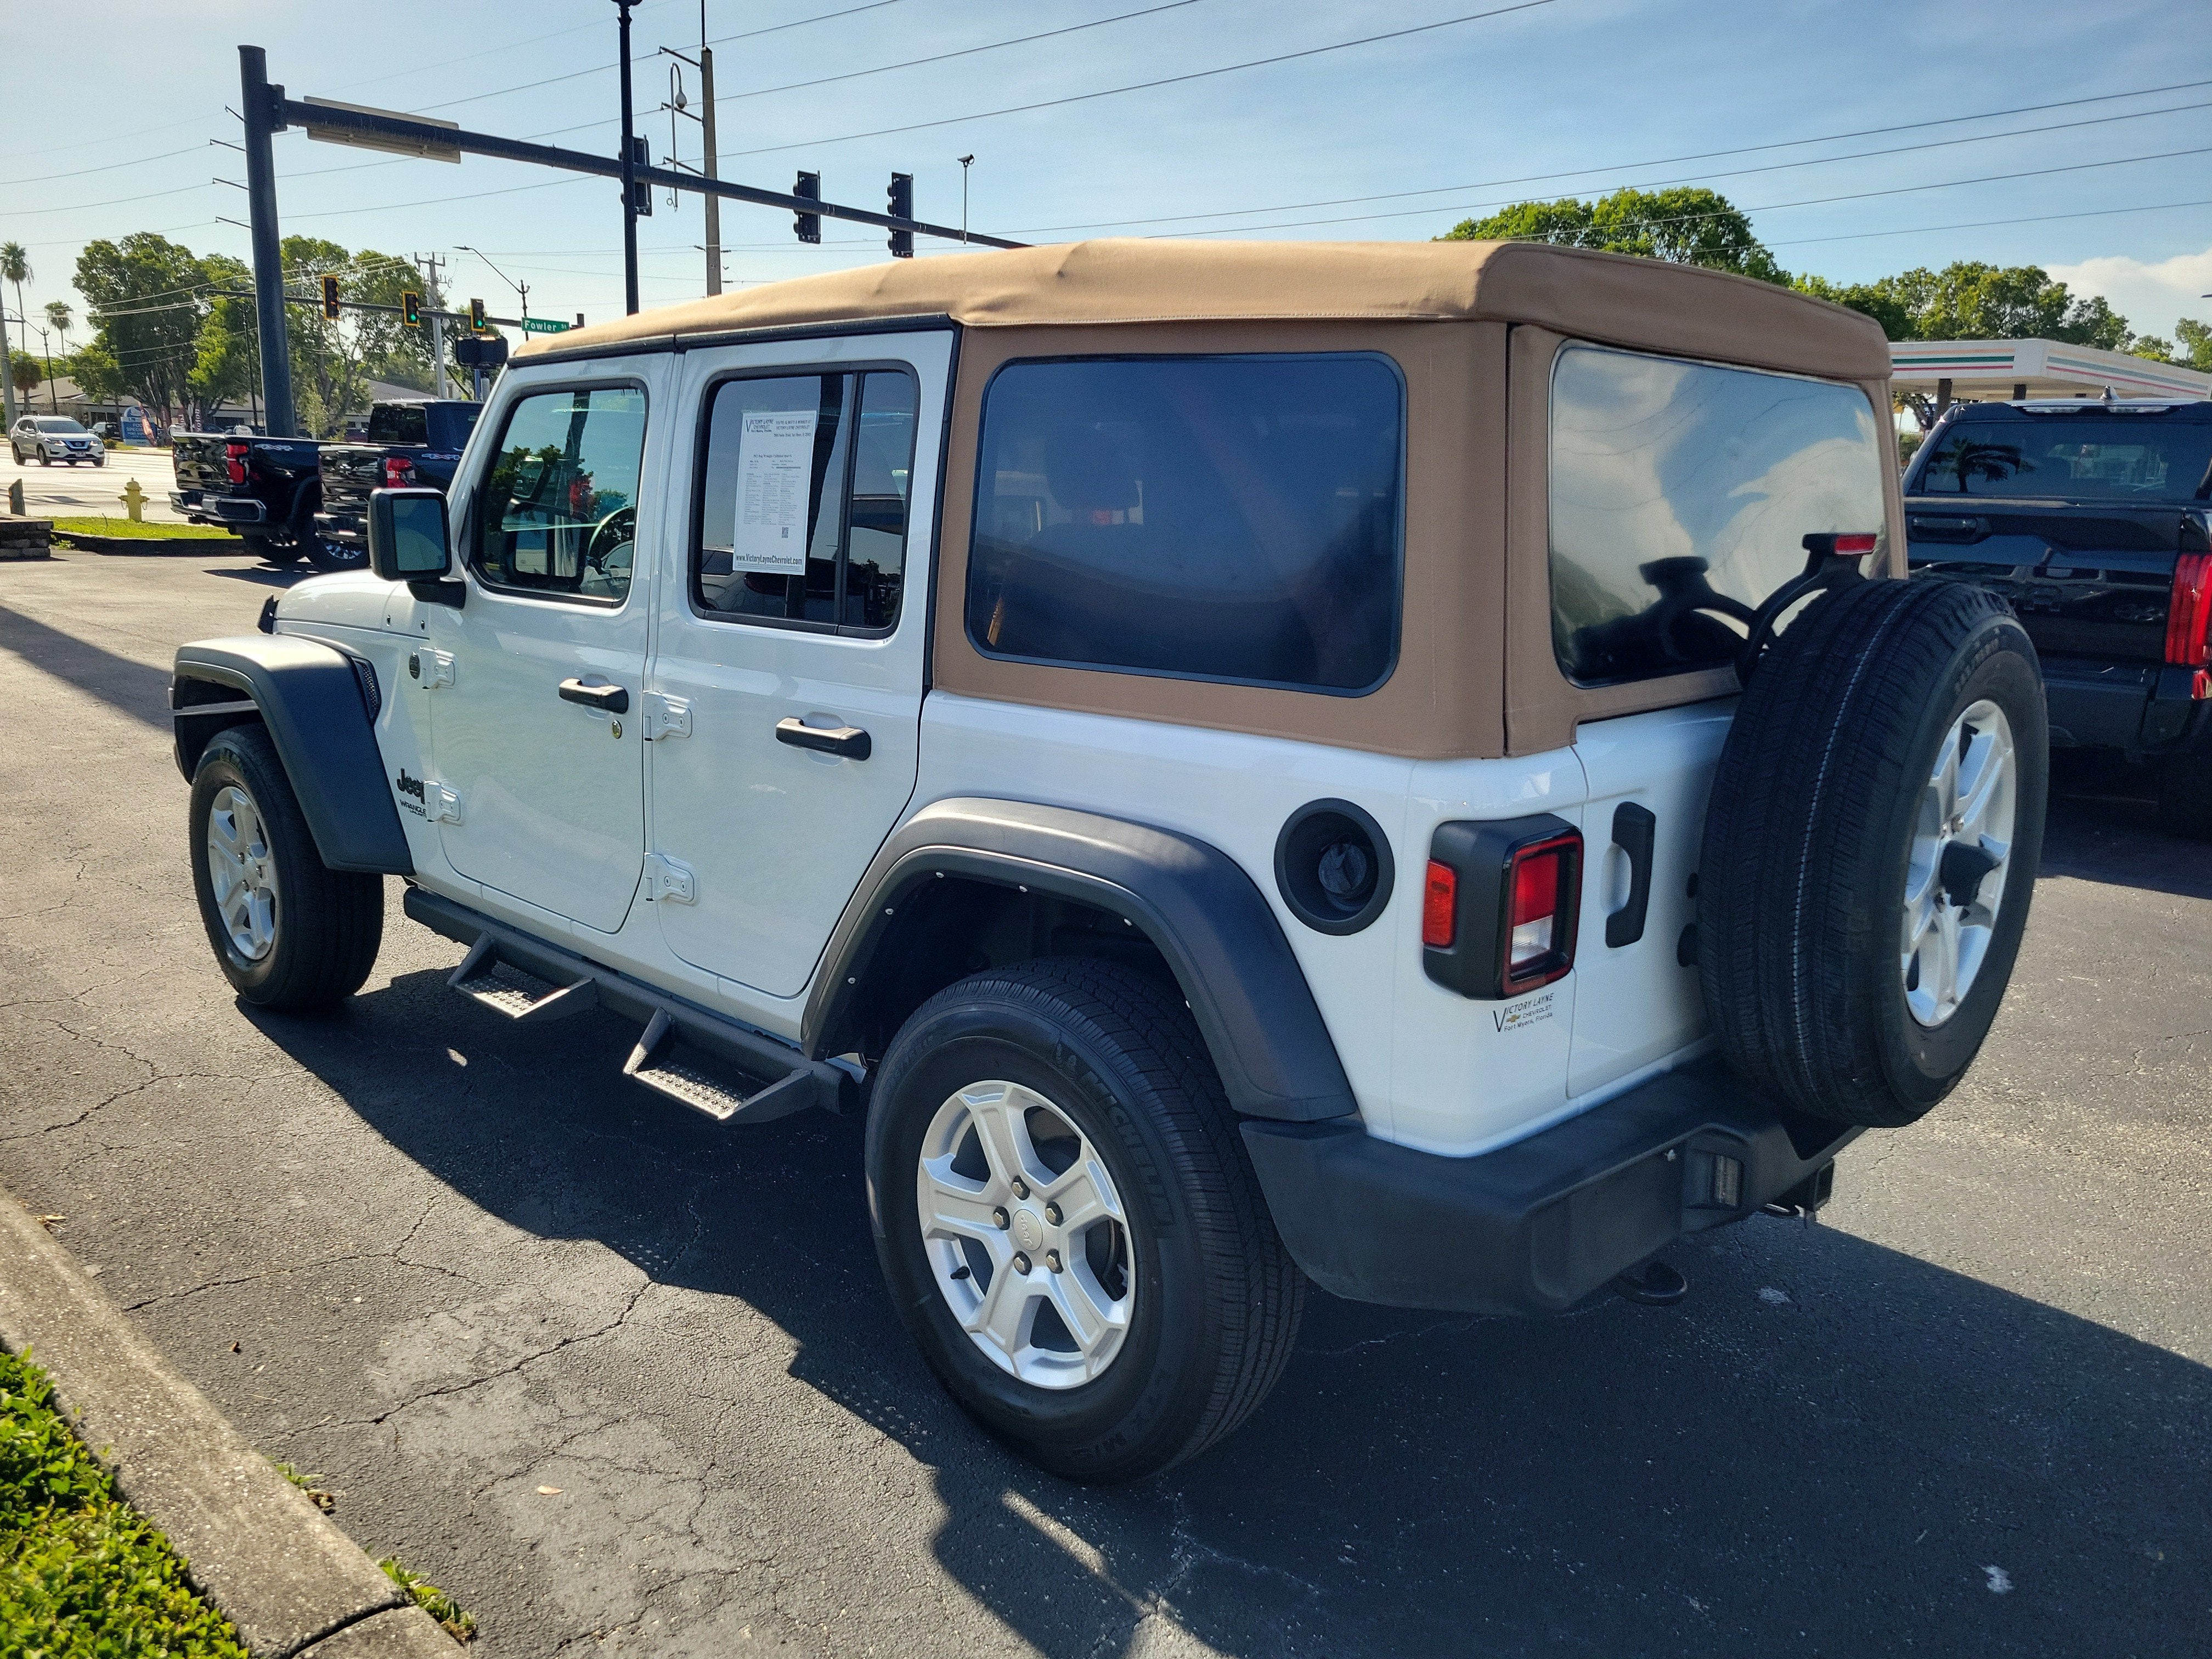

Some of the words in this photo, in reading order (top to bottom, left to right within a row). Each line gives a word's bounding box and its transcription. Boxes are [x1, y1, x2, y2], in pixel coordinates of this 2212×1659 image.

[524, 320, 557, 331] Fowler
[736, 554, 802, 565] www.VictoryLayneChevrolet.com
[1492, 1000, 1532, 1032] VICTORY
[1533, 992, 1554, 1006] LAYNE
[1522, 1005, 1551, 1018] CHEVROLET
[1535, 1012, 1553, 1020] Florida
[1080, 1068, 1175, 1228] MICHELIN
[1021, 1215, 1033, 1246] Jeep
